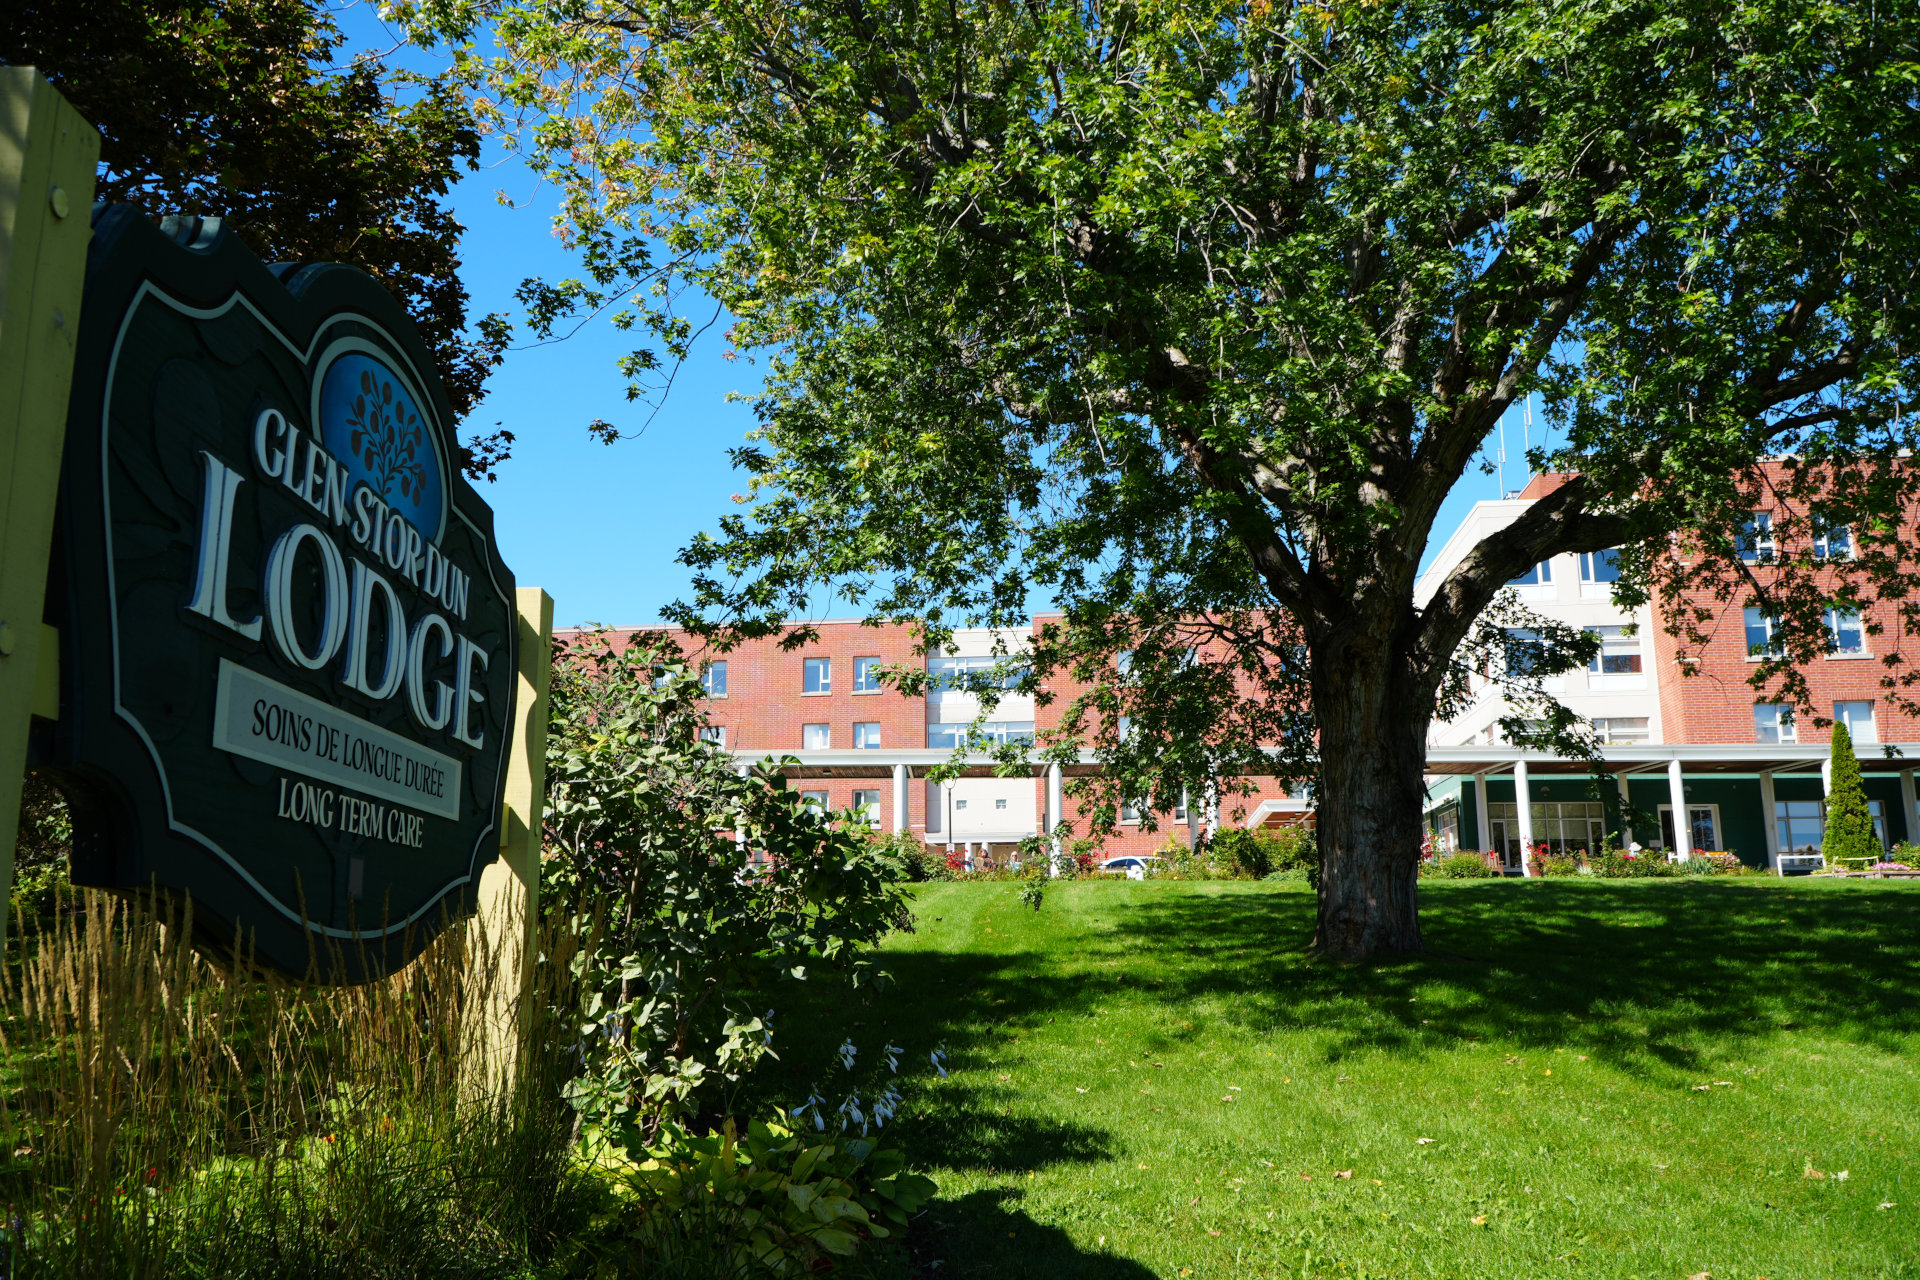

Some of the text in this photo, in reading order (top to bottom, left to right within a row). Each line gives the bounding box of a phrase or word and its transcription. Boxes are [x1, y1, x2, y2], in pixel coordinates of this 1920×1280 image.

[254, 408, 470, 621] GLEN STOR DUN
[184, 450, 489, 751] LODGE
[251, 699, 444, 798] SOINS DE LONGUE DURÉE
[278, 778, 424, 849] LONG TERM CARE
